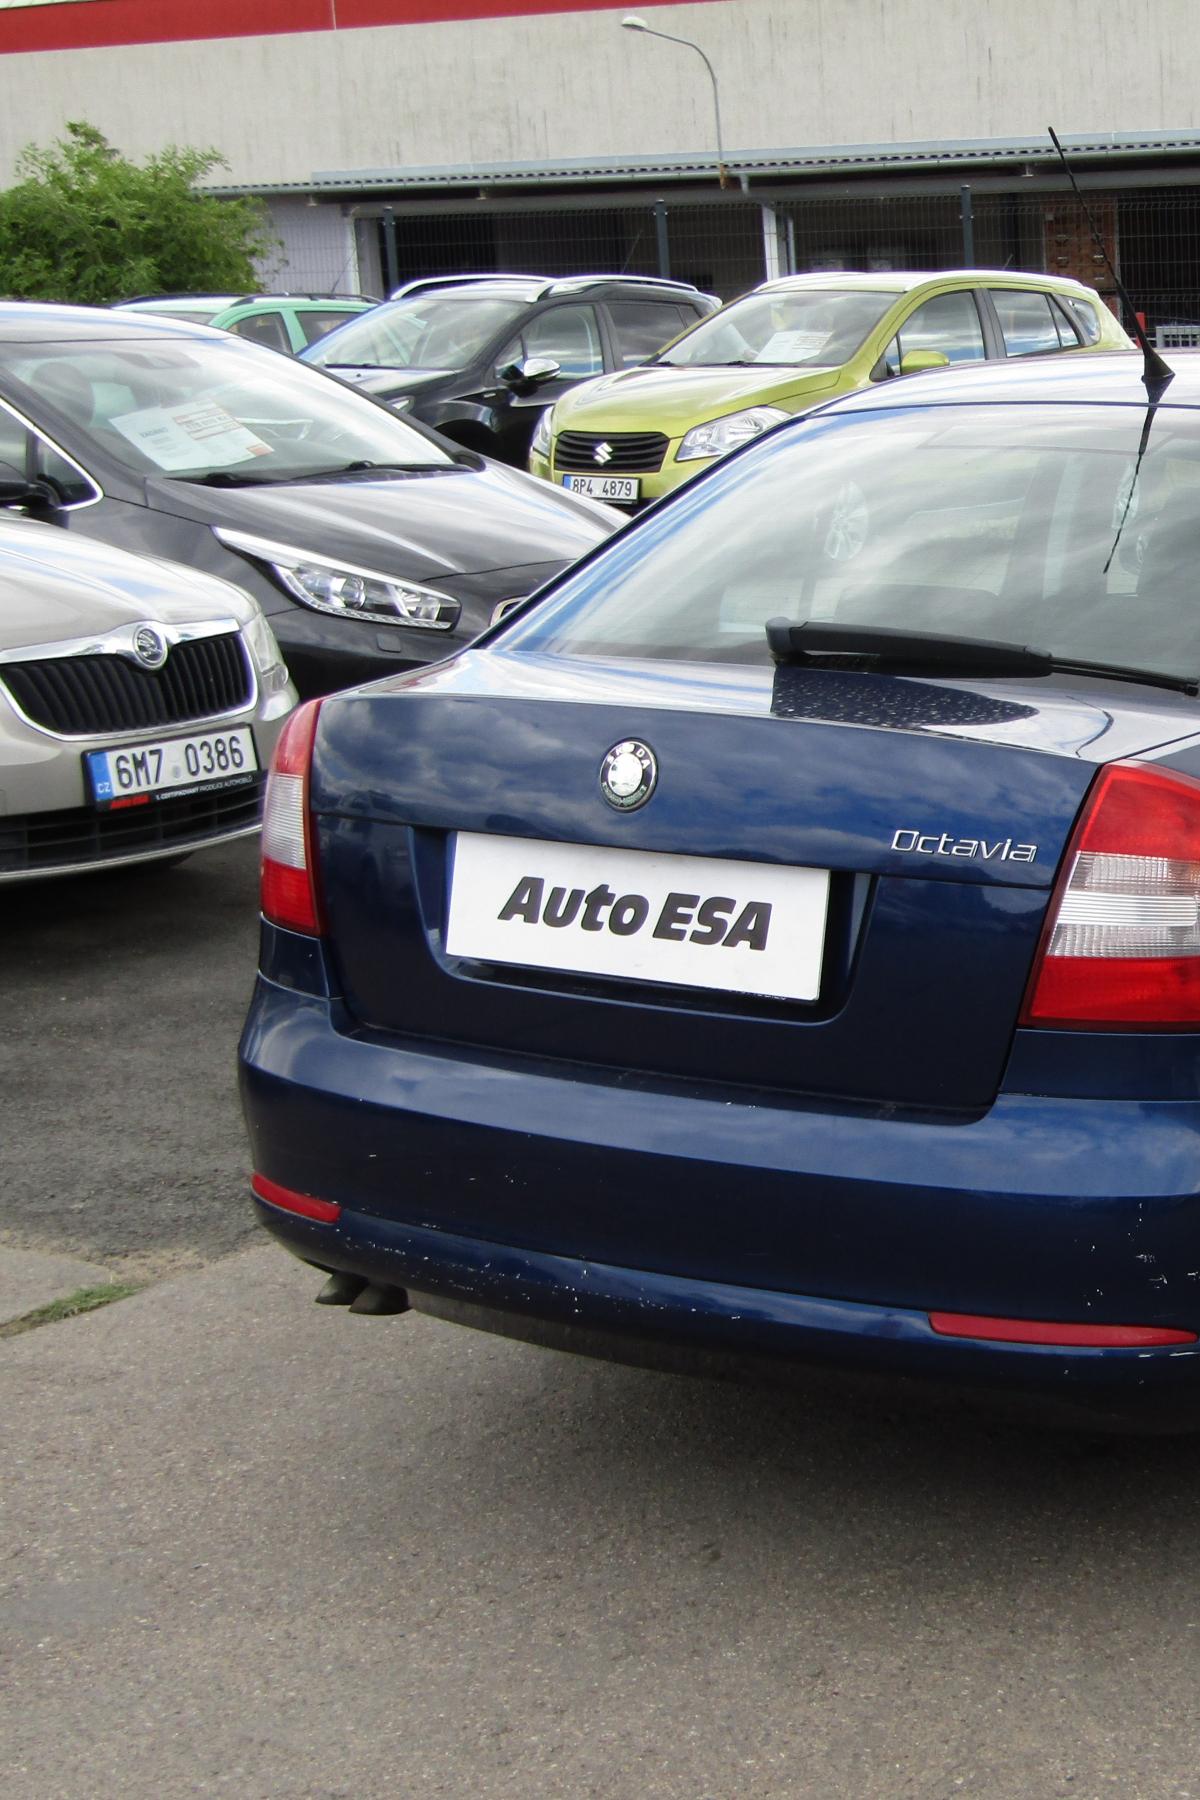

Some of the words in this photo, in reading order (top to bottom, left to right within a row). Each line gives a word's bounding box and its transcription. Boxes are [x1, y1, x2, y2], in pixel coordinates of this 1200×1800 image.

[572, 478, 593, 495] 8P4
[602, 480, 632, 497] 4879
[115, 748, 163, 790] 6M7
[184, 735, 245, 777] 0386
[96, 781, 112, 794] CZ
[891, 829, 1038, 863] Octavia
[496, 875, 650, 937] Auto
[651, 891, 773, 952] ESA
